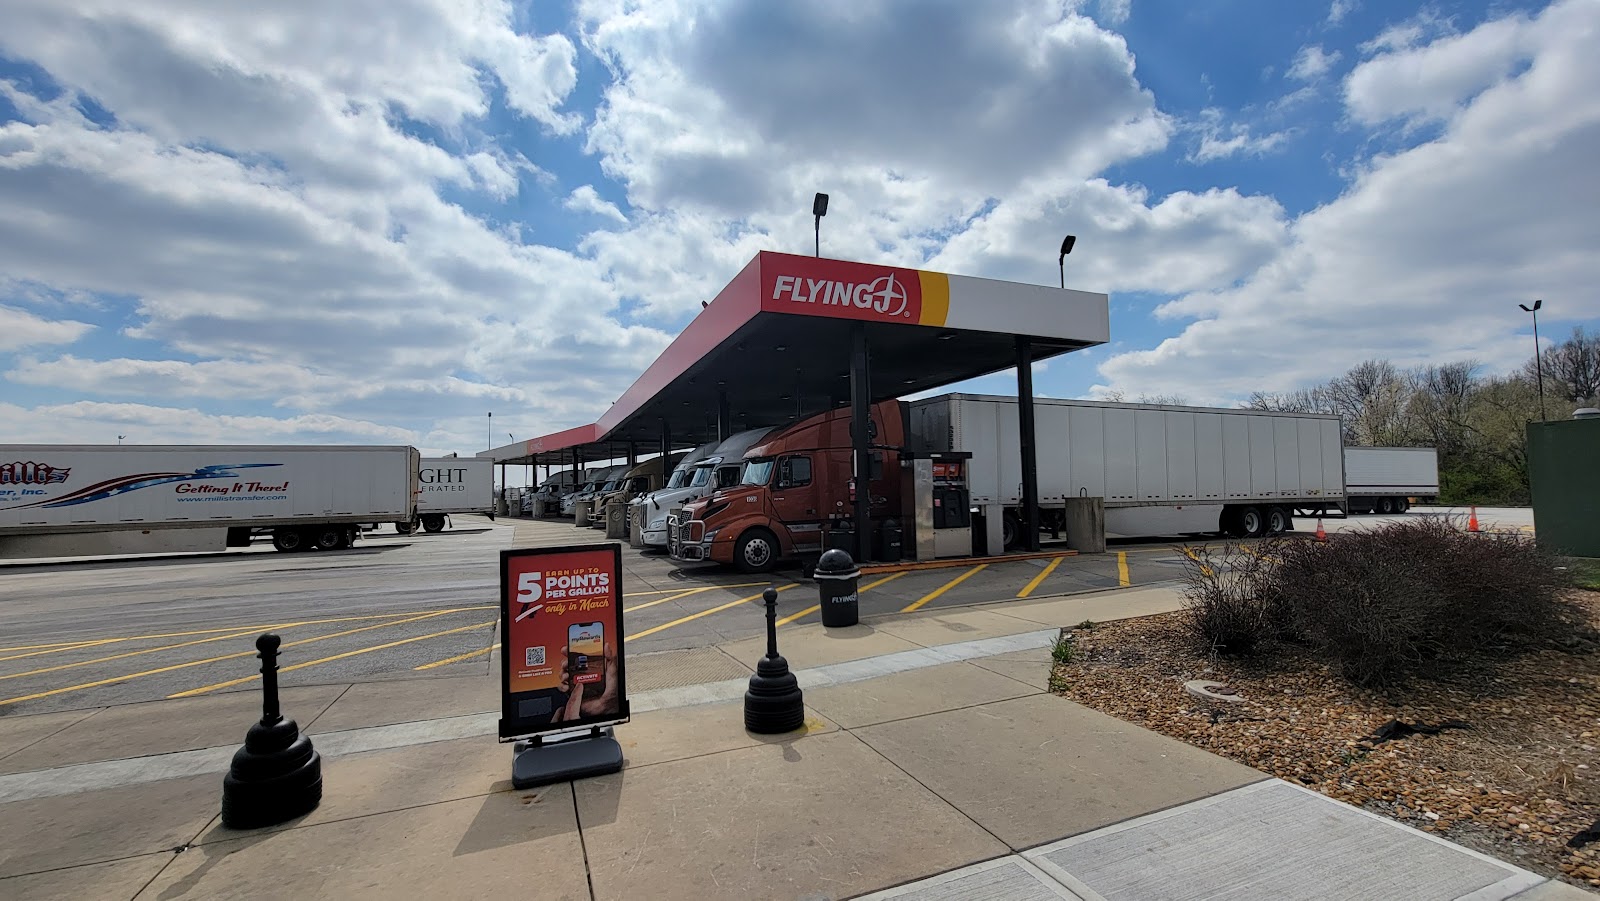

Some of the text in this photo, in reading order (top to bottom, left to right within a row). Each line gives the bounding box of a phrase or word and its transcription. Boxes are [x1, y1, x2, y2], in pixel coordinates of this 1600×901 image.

[175, 481, 289, 495] Getting It There!
[176, 494, 287, 502] www.millistransfer.com
[516, 572, 609, 603] 5 POINTS
[545, 586, 609, 598] PER GALLON
[545, 599, 609, 615] only in March
